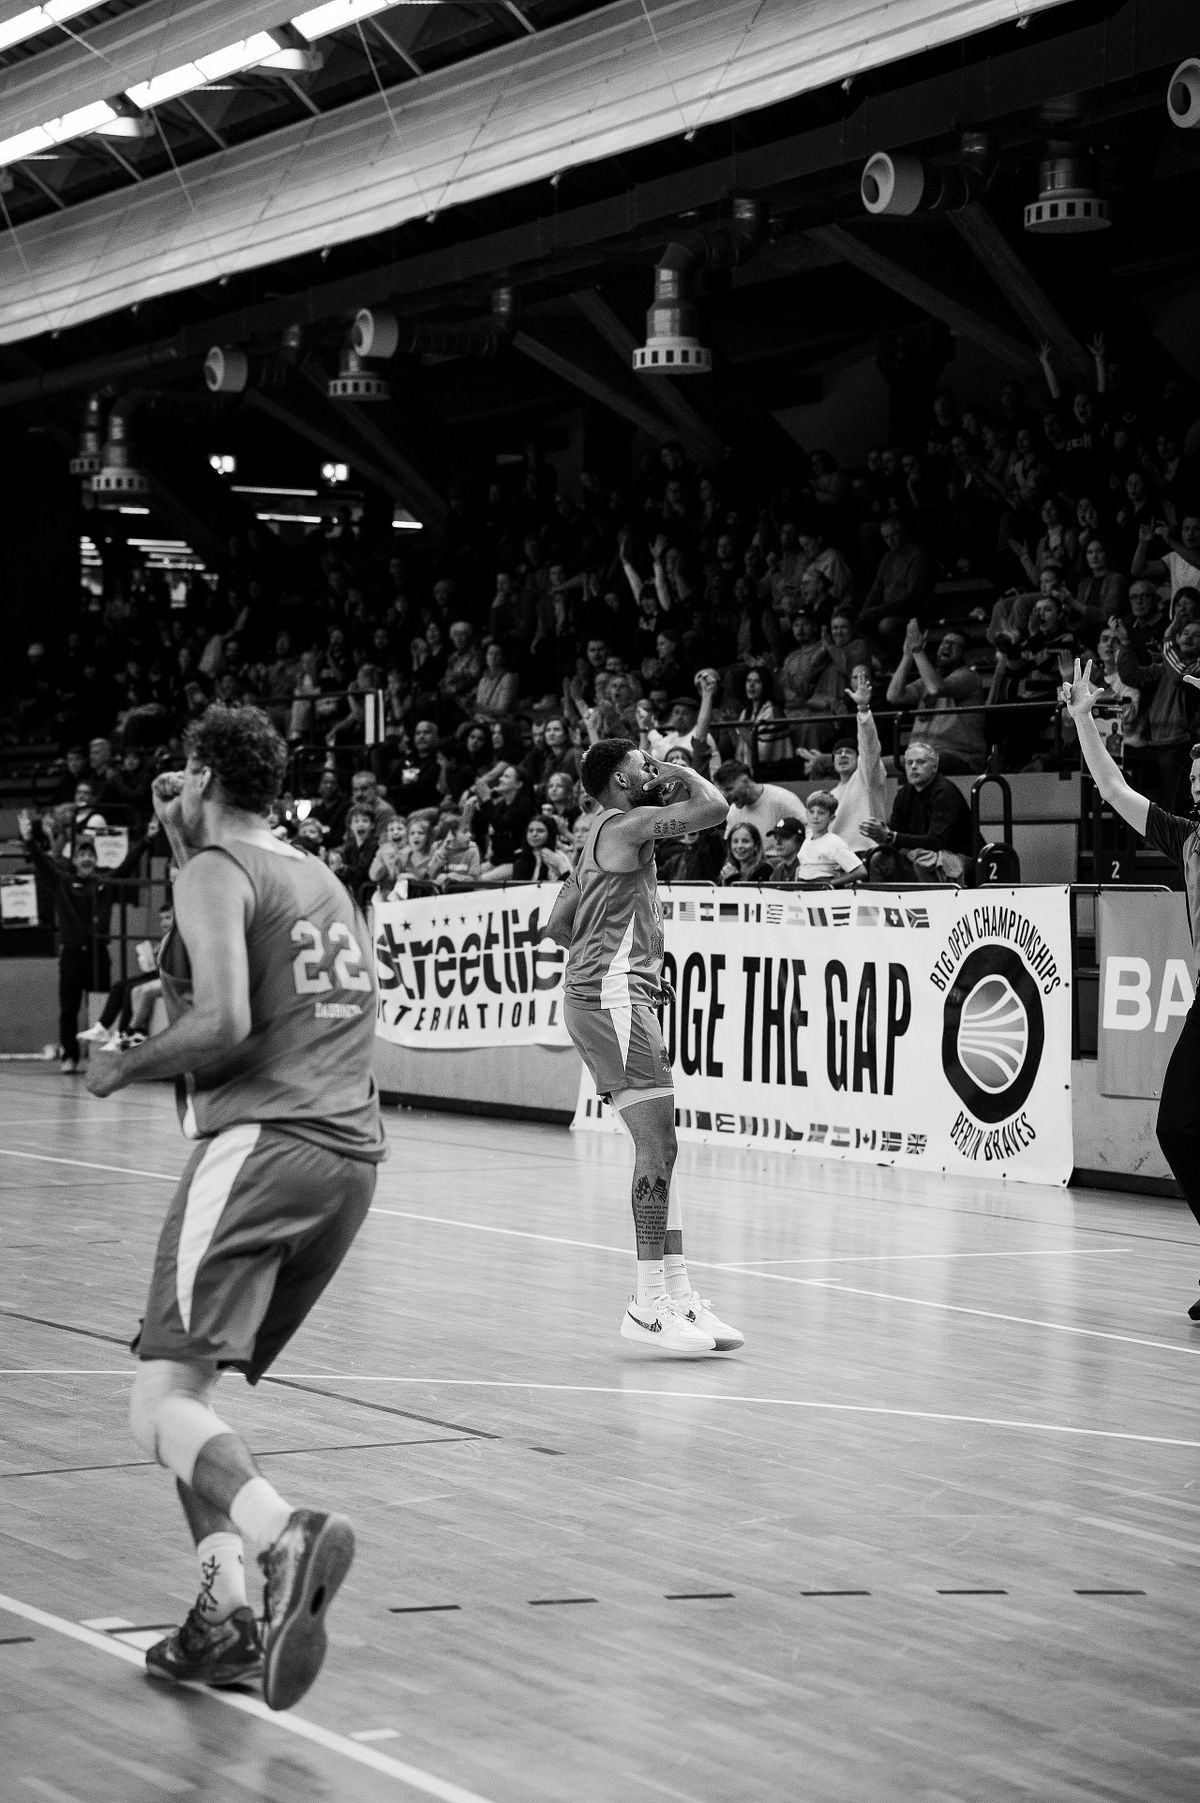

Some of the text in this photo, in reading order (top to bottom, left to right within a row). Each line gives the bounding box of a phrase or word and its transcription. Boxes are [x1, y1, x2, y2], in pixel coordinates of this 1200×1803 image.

[989, 862, 998, 880] 2
[1111, 860, 1120, 879] 2
[290, 919, 372, 994] 22
[929, 905, 1061, 995] BIG OPEN CHAMPIONSHIPS
[742, 956, 808, 1087] THE
[824, 959, 912, 1095] GAP
[950, 1110, 1036, 1161] BERLIN BRAVES
